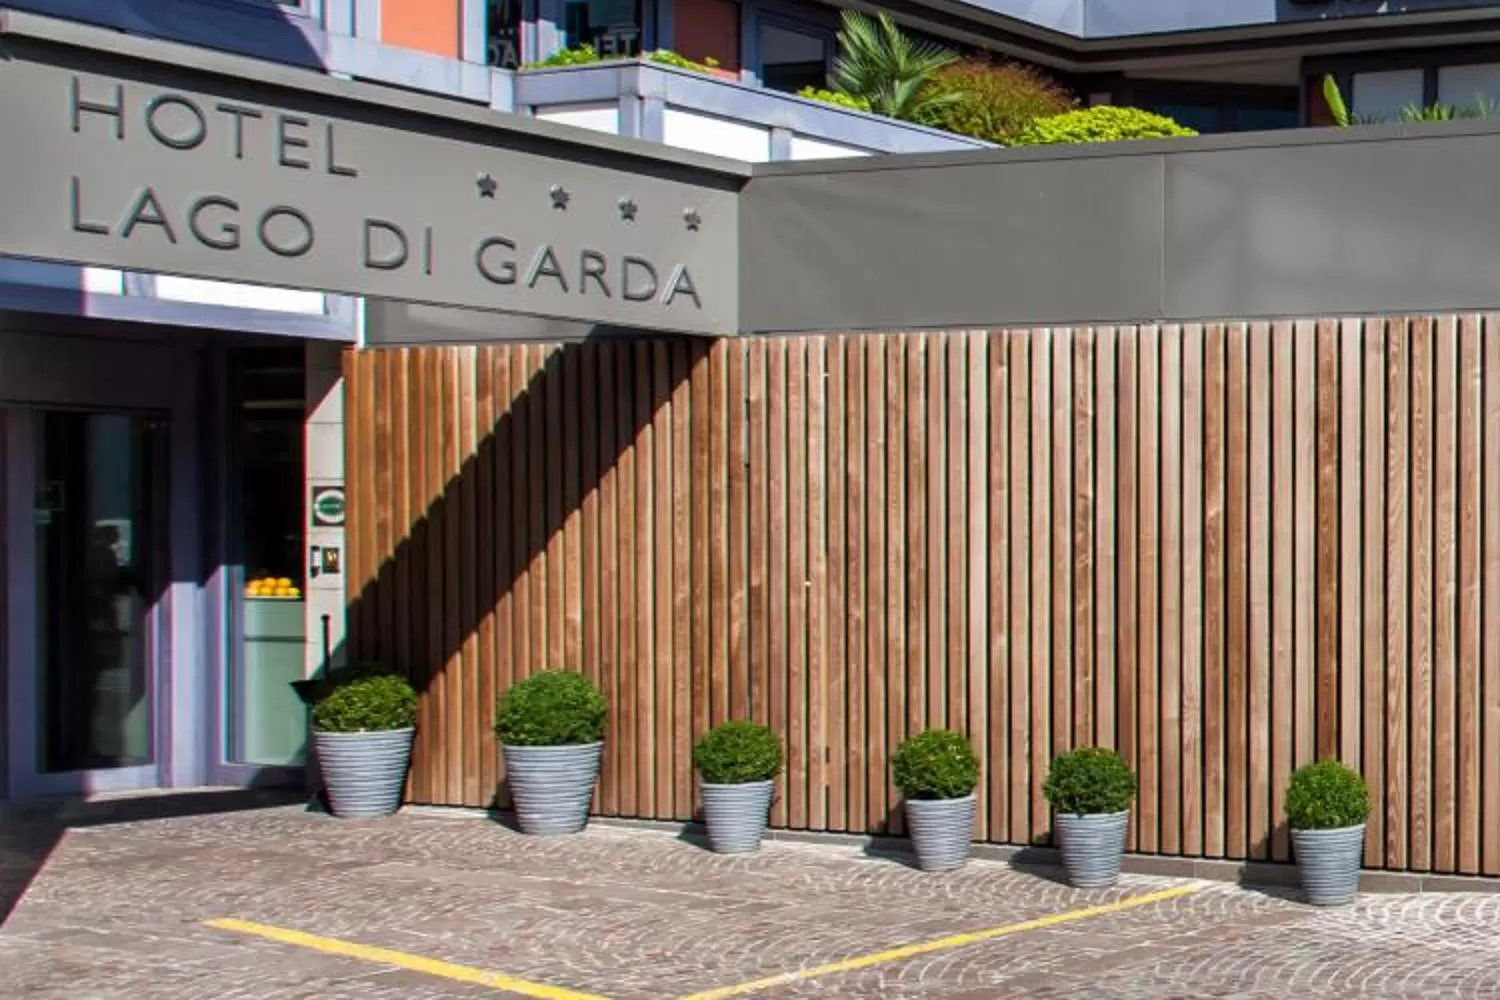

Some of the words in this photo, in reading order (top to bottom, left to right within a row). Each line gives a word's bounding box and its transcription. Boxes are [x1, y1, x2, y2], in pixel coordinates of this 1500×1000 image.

[70, 76, 358, 179] HOTEL
[70, 175, 315, 259] LAGO
[363, 218, 433, 276] DI
[475, 236, 703, 311] GARDA
